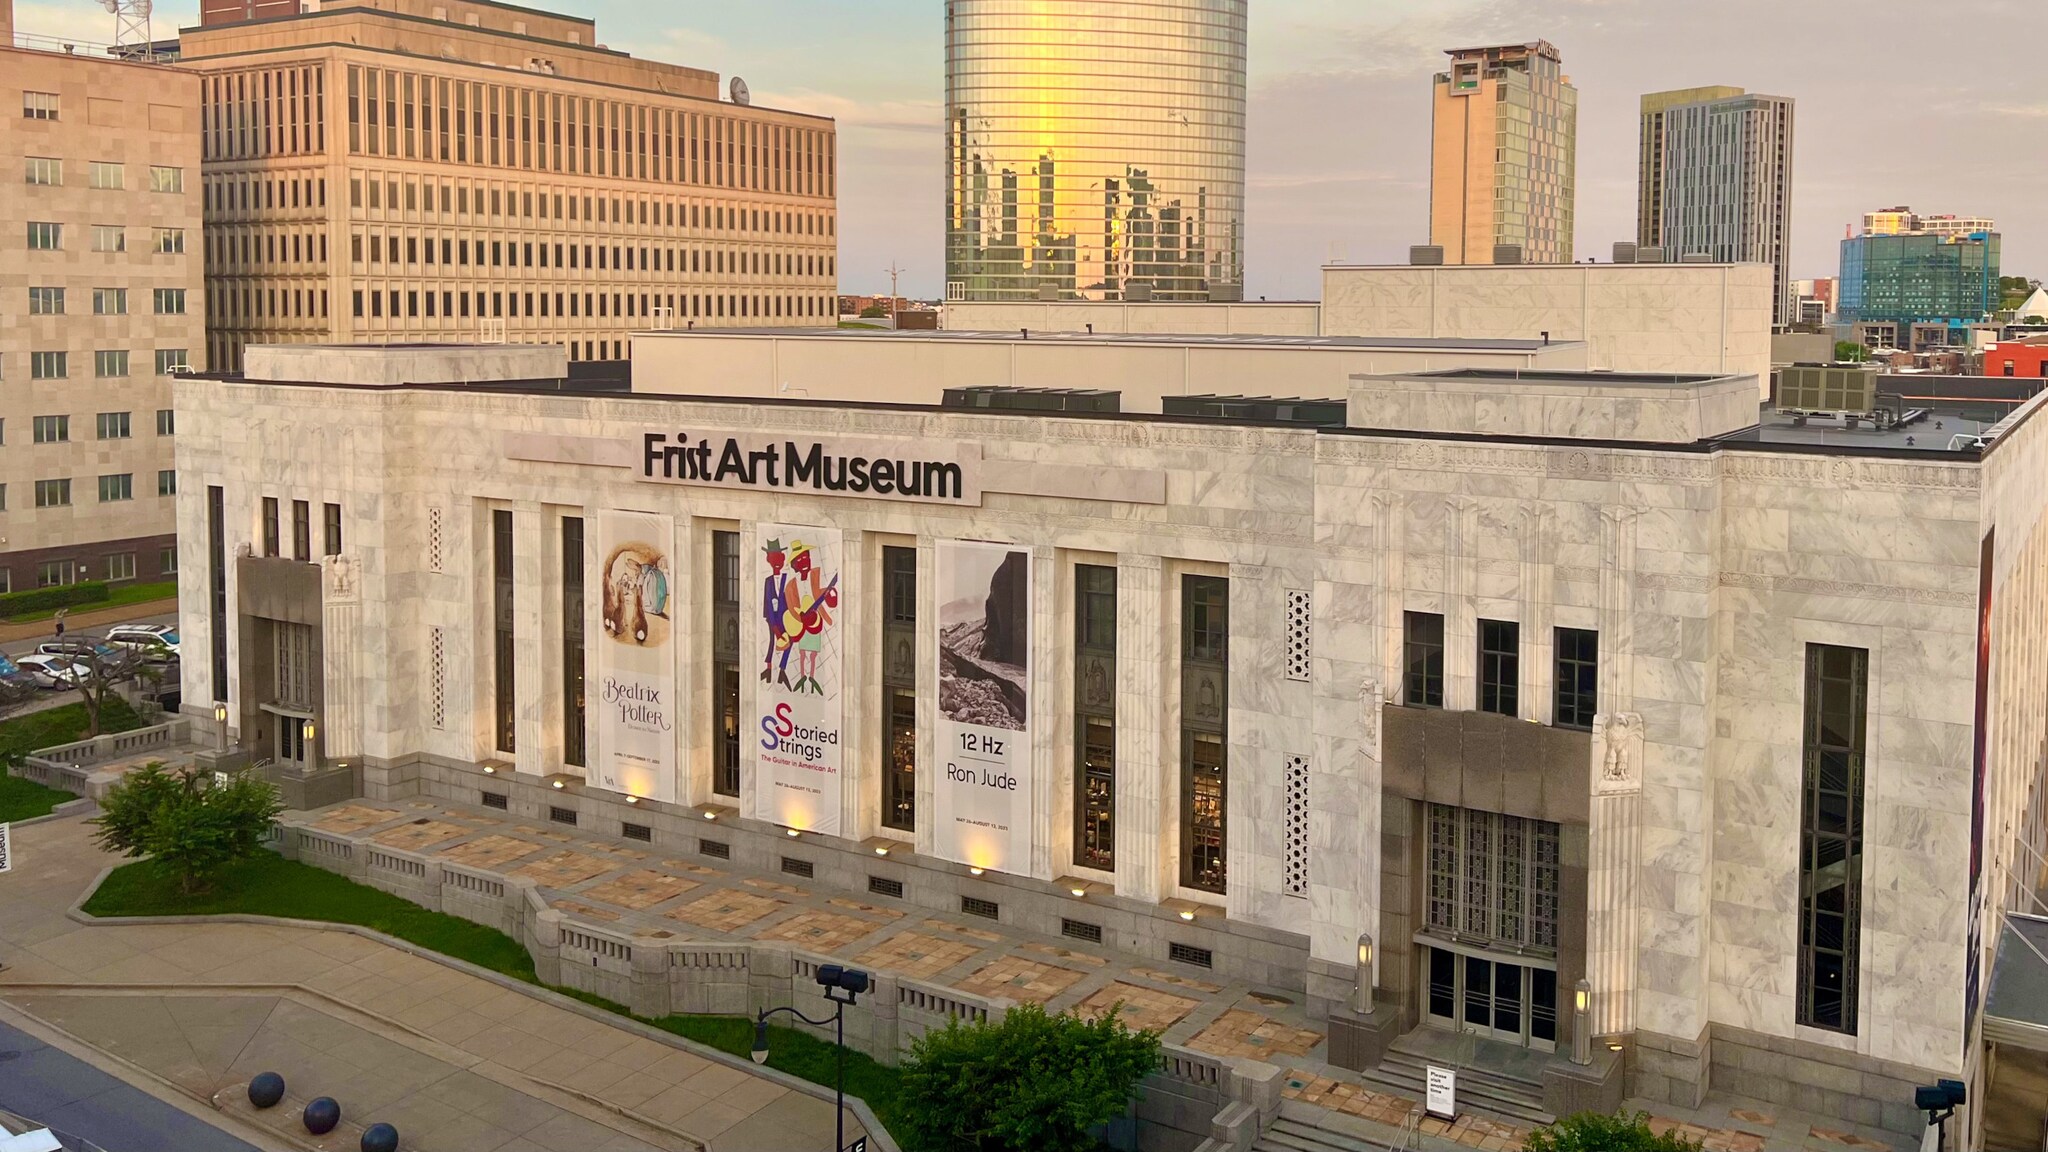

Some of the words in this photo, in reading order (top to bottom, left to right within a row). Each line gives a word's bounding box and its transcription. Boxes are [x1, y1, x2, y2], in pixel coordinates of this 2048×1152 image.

[644, 432, 711, 481] Frist
[714, 438, 779, 486] Art
[785, 441, 962, 499] Museum
[602, 676, 661, 705] Beatrix
[618, 699, 671, 731] Potter
[775, 702, 837, 745] Storied
[761, 715, 822, 761] Strings
[960, 732, 977, 751] 12
[982, 735, 1004, 756] Hz
[761, 754, 771, 762] The
[772, 756, 791, 766] Guitar
[798, 761, 826, 772] American
[947, 762, 976, 784] Ron
[981, 768, 1017, 791] Jude
[1430, 1071, 1447, 1079] Please
[1430, 1083, 1450, 1091] another
